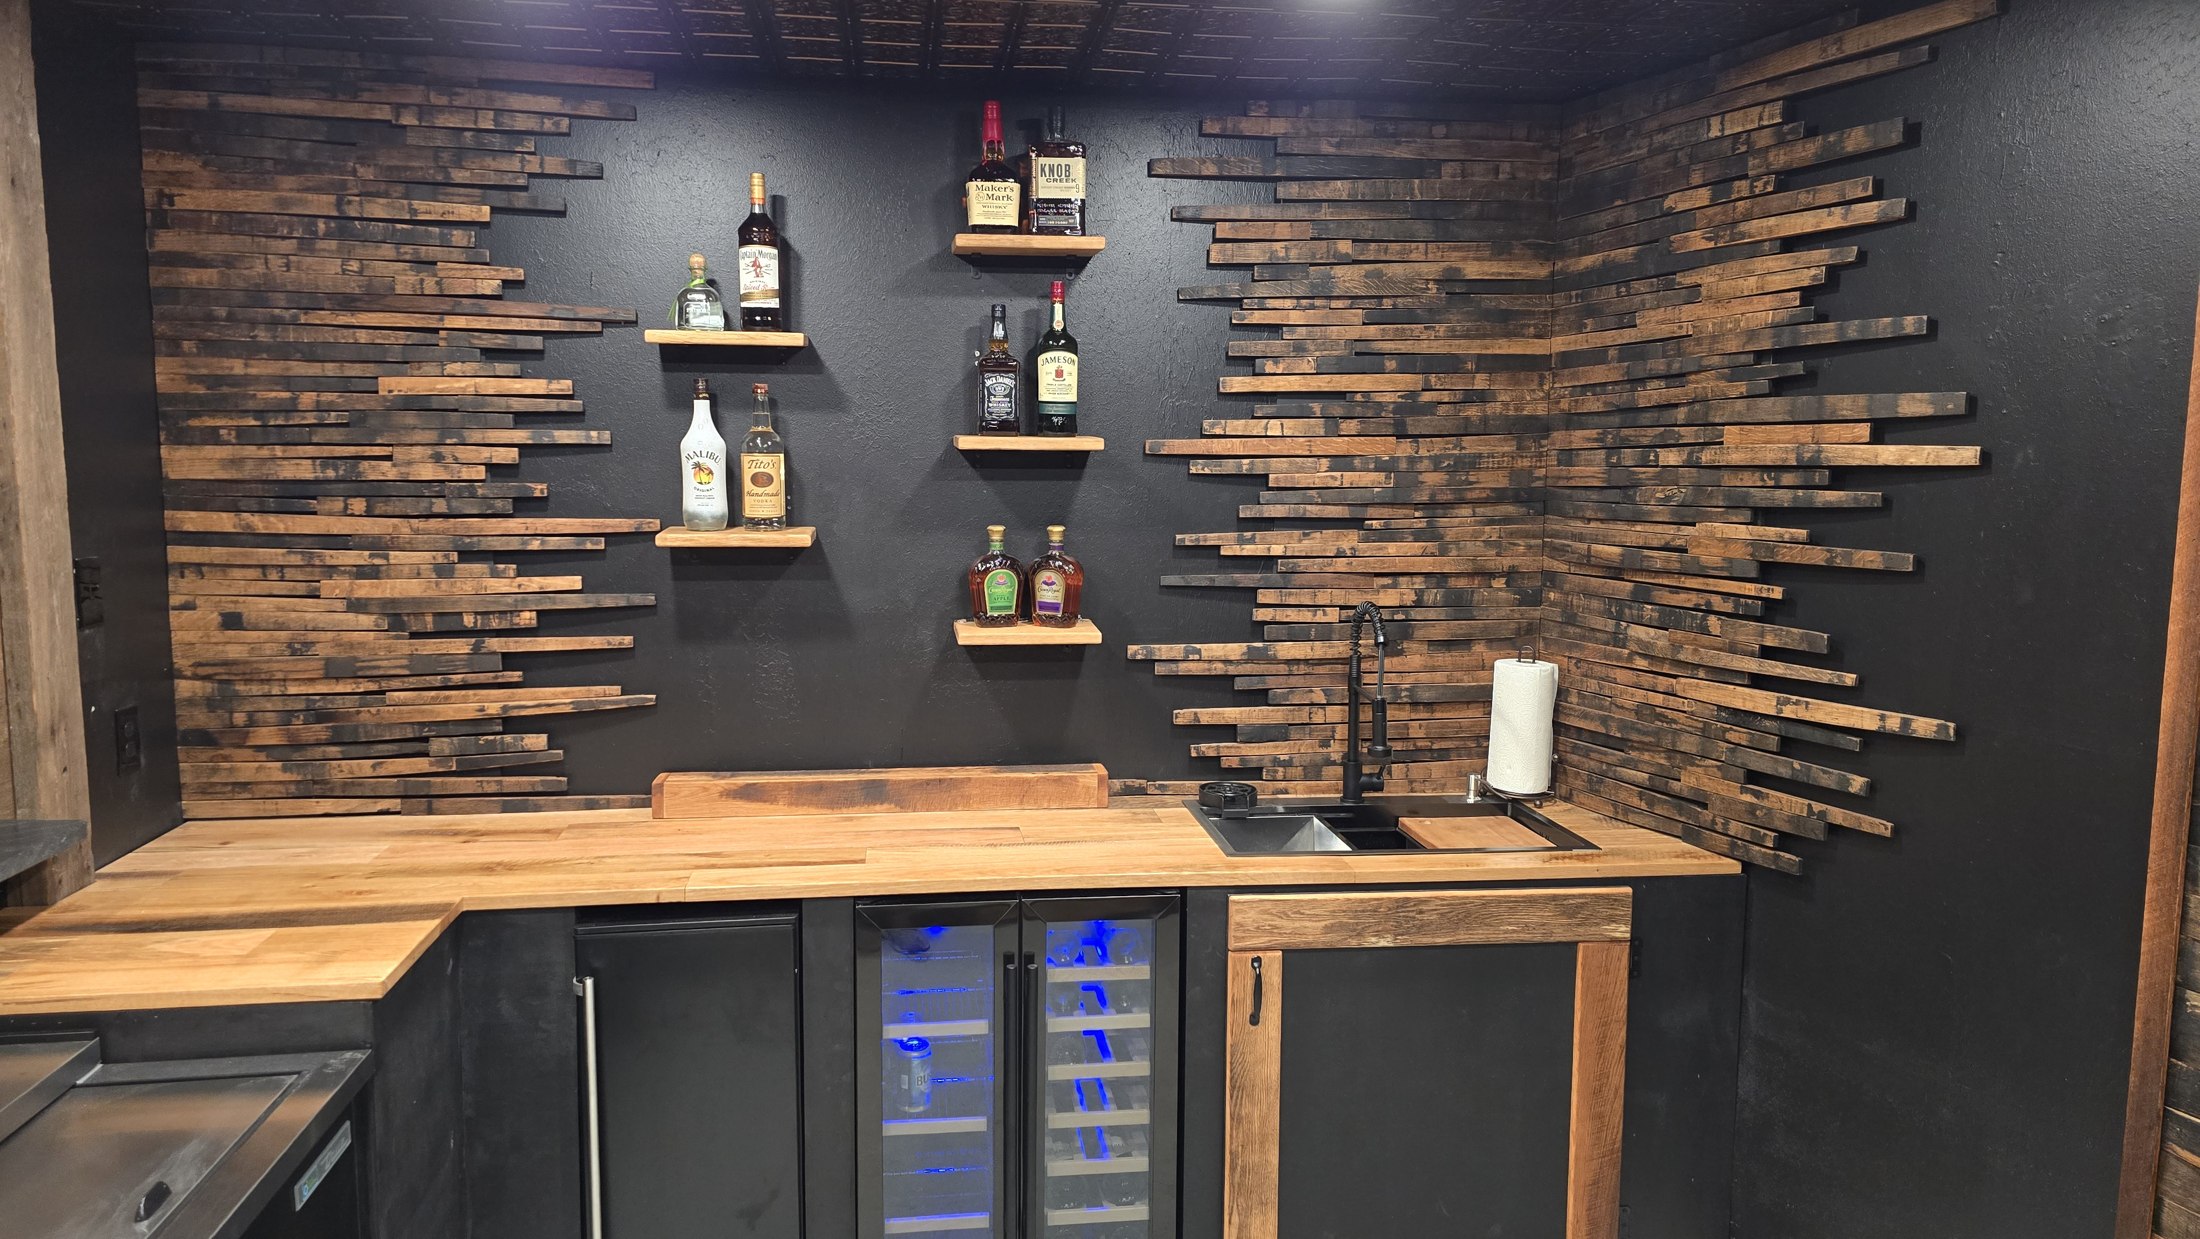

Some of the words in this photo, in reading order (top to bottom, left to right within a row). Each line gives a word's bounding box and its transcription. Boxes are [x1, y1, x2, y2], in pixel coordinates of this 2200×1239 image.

[1040, 163, 1071, 178] KNOB
[975, 184, 1015, 193] Maker's
[1075, 183, 1080, 193] 9
[985, 193, 1014, 202] Mark
[757, 249, 778, 261] Morgan
[1040, 355, 1077, 367] JAMESON
[684, 449, 722, 465] MALIBU
[747, 458, 777, 470] Tito's
[745, 488, 780, 498] Handmade
